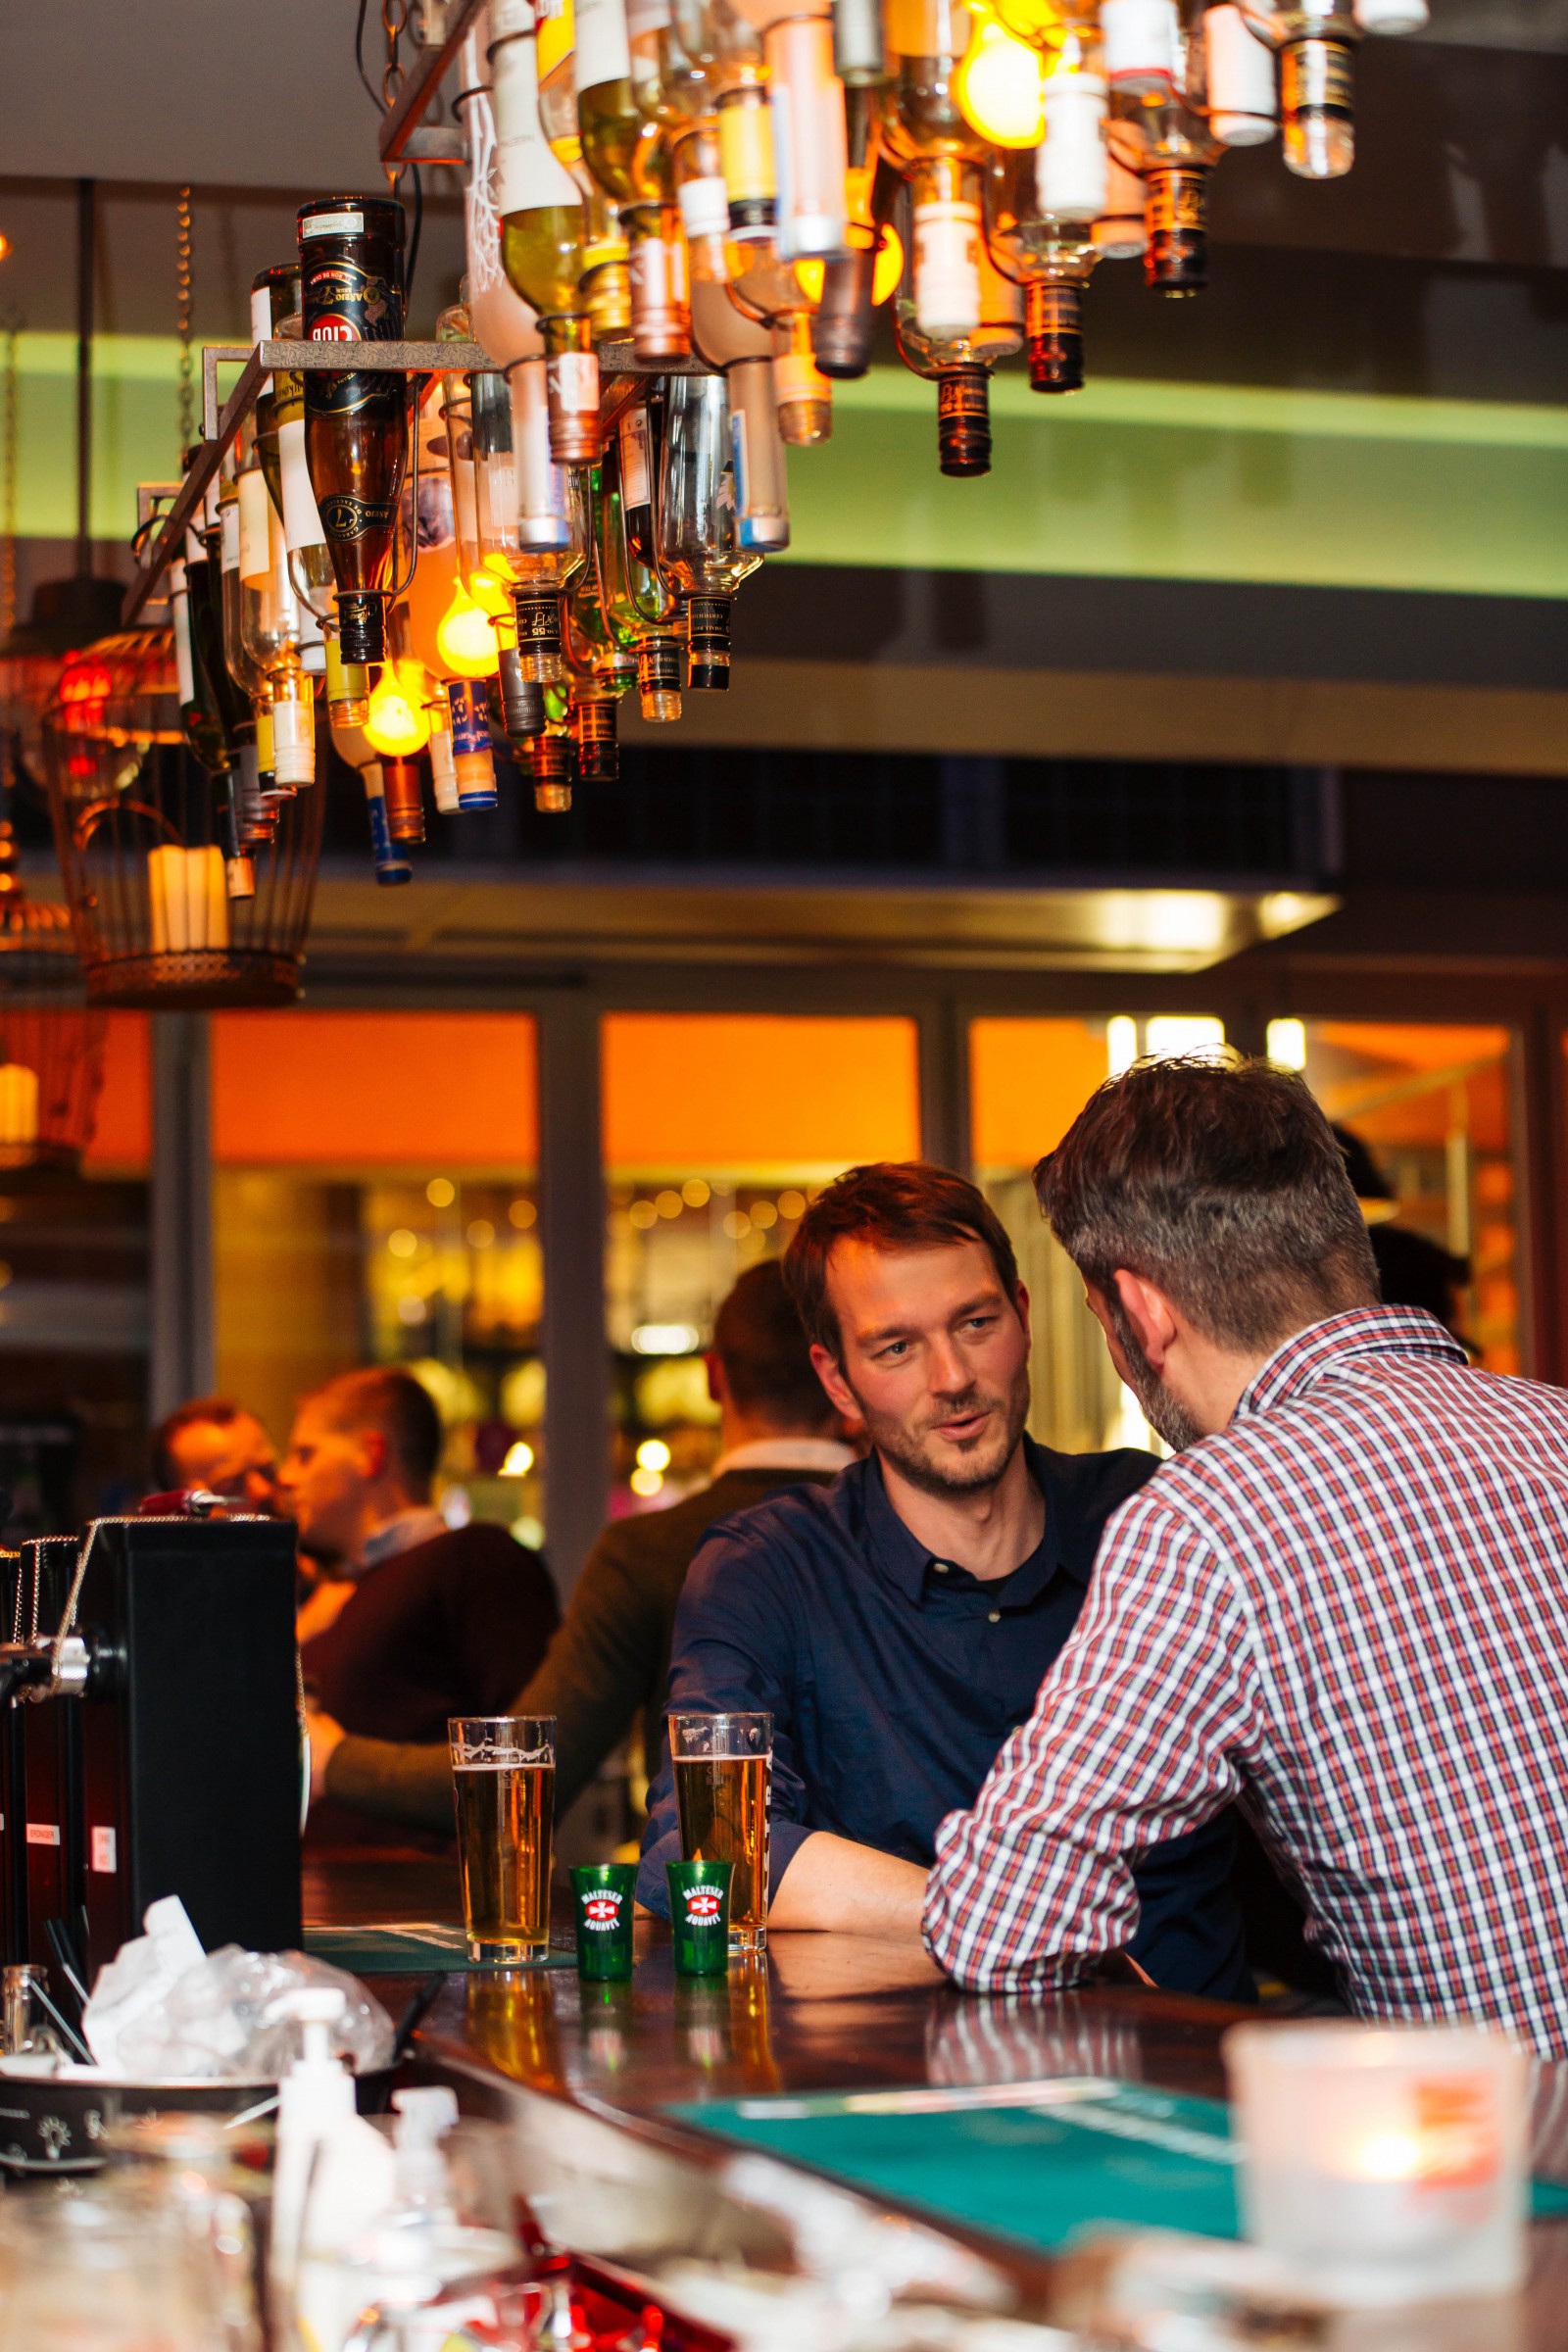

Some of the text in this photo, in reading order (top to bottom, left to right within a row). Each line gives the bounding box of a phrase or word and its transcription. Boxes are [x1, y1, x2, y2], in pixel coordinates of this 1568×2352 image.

[310, 274, 321, 285] CUBA
[335, 508, 347, 527] 7
[365, 510, 389, 519] AÑEJO
[531, 627, 546, 637] 55
[581, 1889, 623, 1904] MALTESER
[683, 1885, 724, 1900] MALTESER
[583, 1917, 620, 1932] AQUAVIT
[685, 1913, 721, 1927] AQUAVIT
